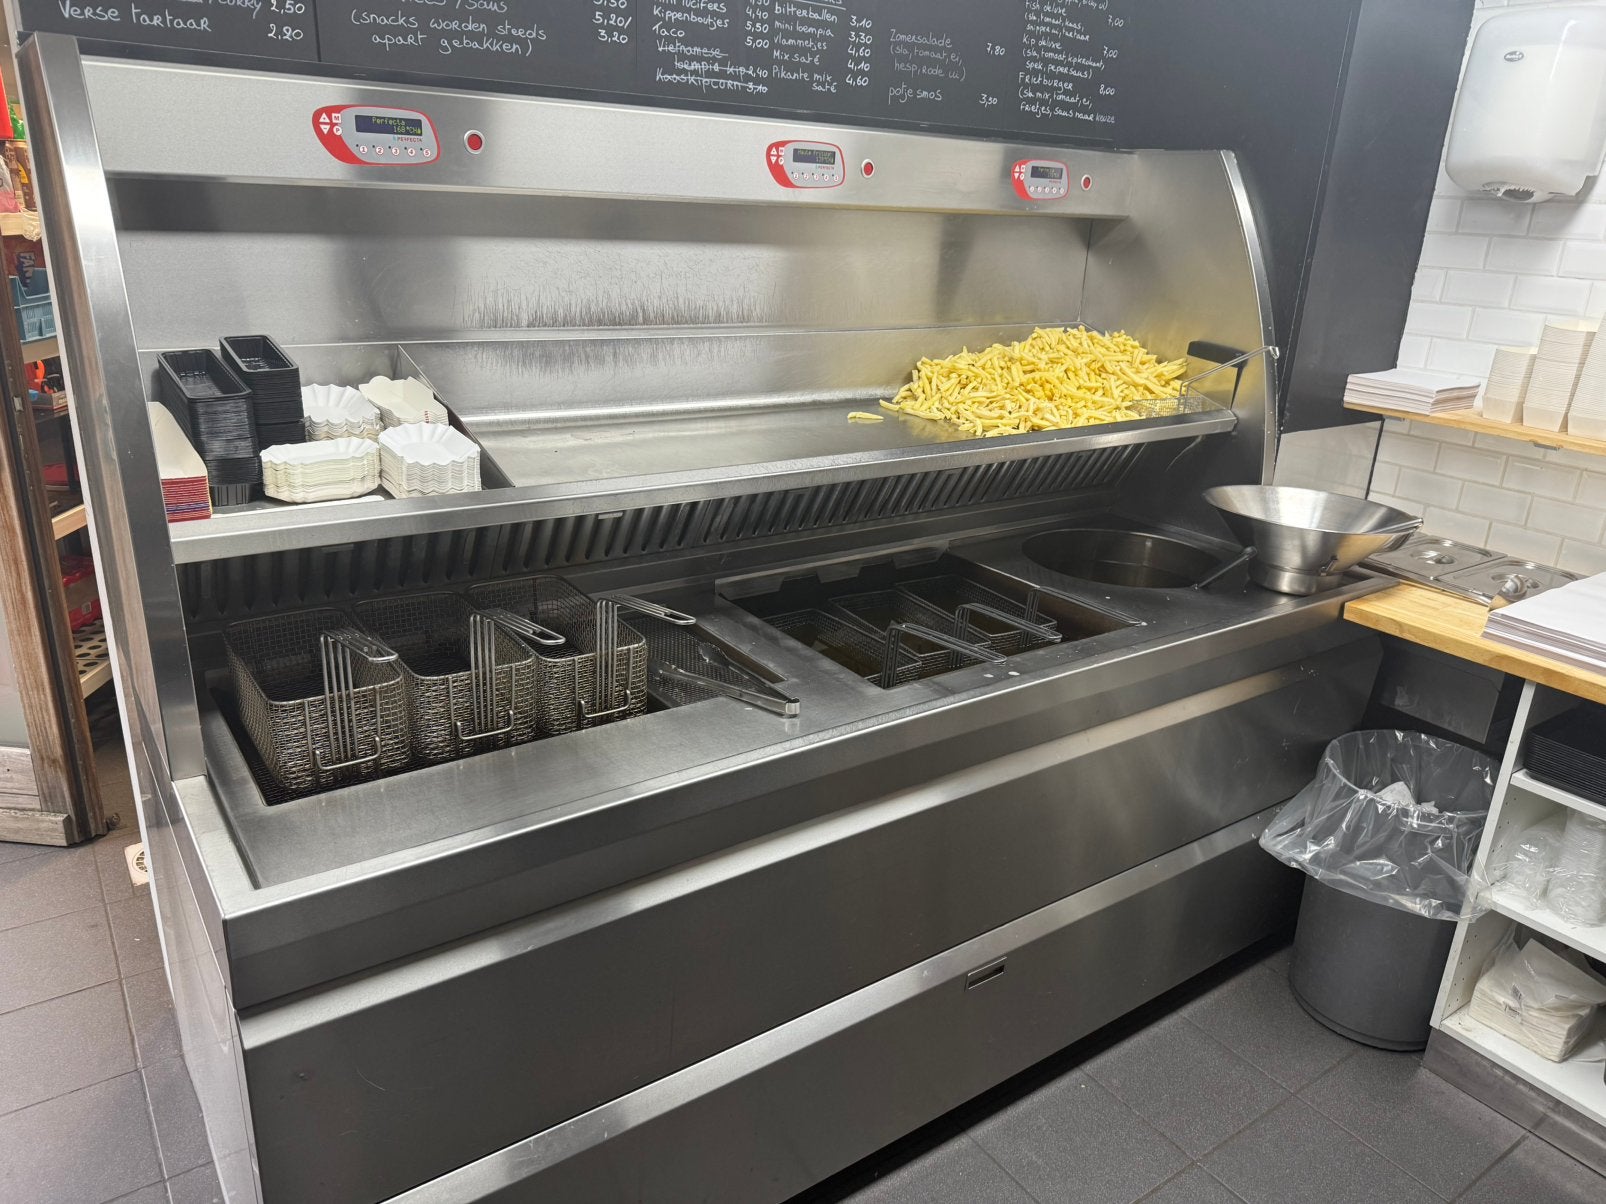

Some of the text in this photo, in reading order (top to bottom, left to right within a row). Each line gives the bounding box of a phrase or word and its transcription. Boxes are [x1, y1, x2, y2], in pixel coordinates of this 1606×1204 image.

[58, 0, 121, 20] Verse
[270, 0, 305, 14] 2,50
[745, 6, 769, 20] 4,40
[774, 2, 838, 23] bitterballen
[351, 9, 548, 41] (snacks worden steeds
[653, 5, 730, 30] Kippenboutjes
[849, 15, 873, 29] 3,10
[1107, 14, 1124, 28] 7,00
[267, 23, 304, 41] 2,20
[652, 21, 686, 37] Taco
[744, 20, 770, 33] 5,50
[774, 20, 834, 38] mini loempia
[371, 30, 532, 57] apart gebakken)
[597, 28, 628, 44] 3,20
[744, 36, 770, 48] 5,00
[773, 32, 828, 50] vlammetjes
[848, 31, 873, 44] 3,30
[890, 28, 953, 48] Zomersalade
[656, 38, 728, 58] Vietnamese
[773, 49, 790, 61] Mix
[847, 45, 871, 57] 4,60
[914, 46, 949, 65] tomaat,
[986, 42, 1006, 56] 7,80
[1103, 45, 1119, 58] 7,00
[772, 64, 833, 82] Pikante mix
[847, 59, 871, 72] 4,10
[845, 73, 870, 87] 4,60
[1099, 83, 1116, 96] 8,00
